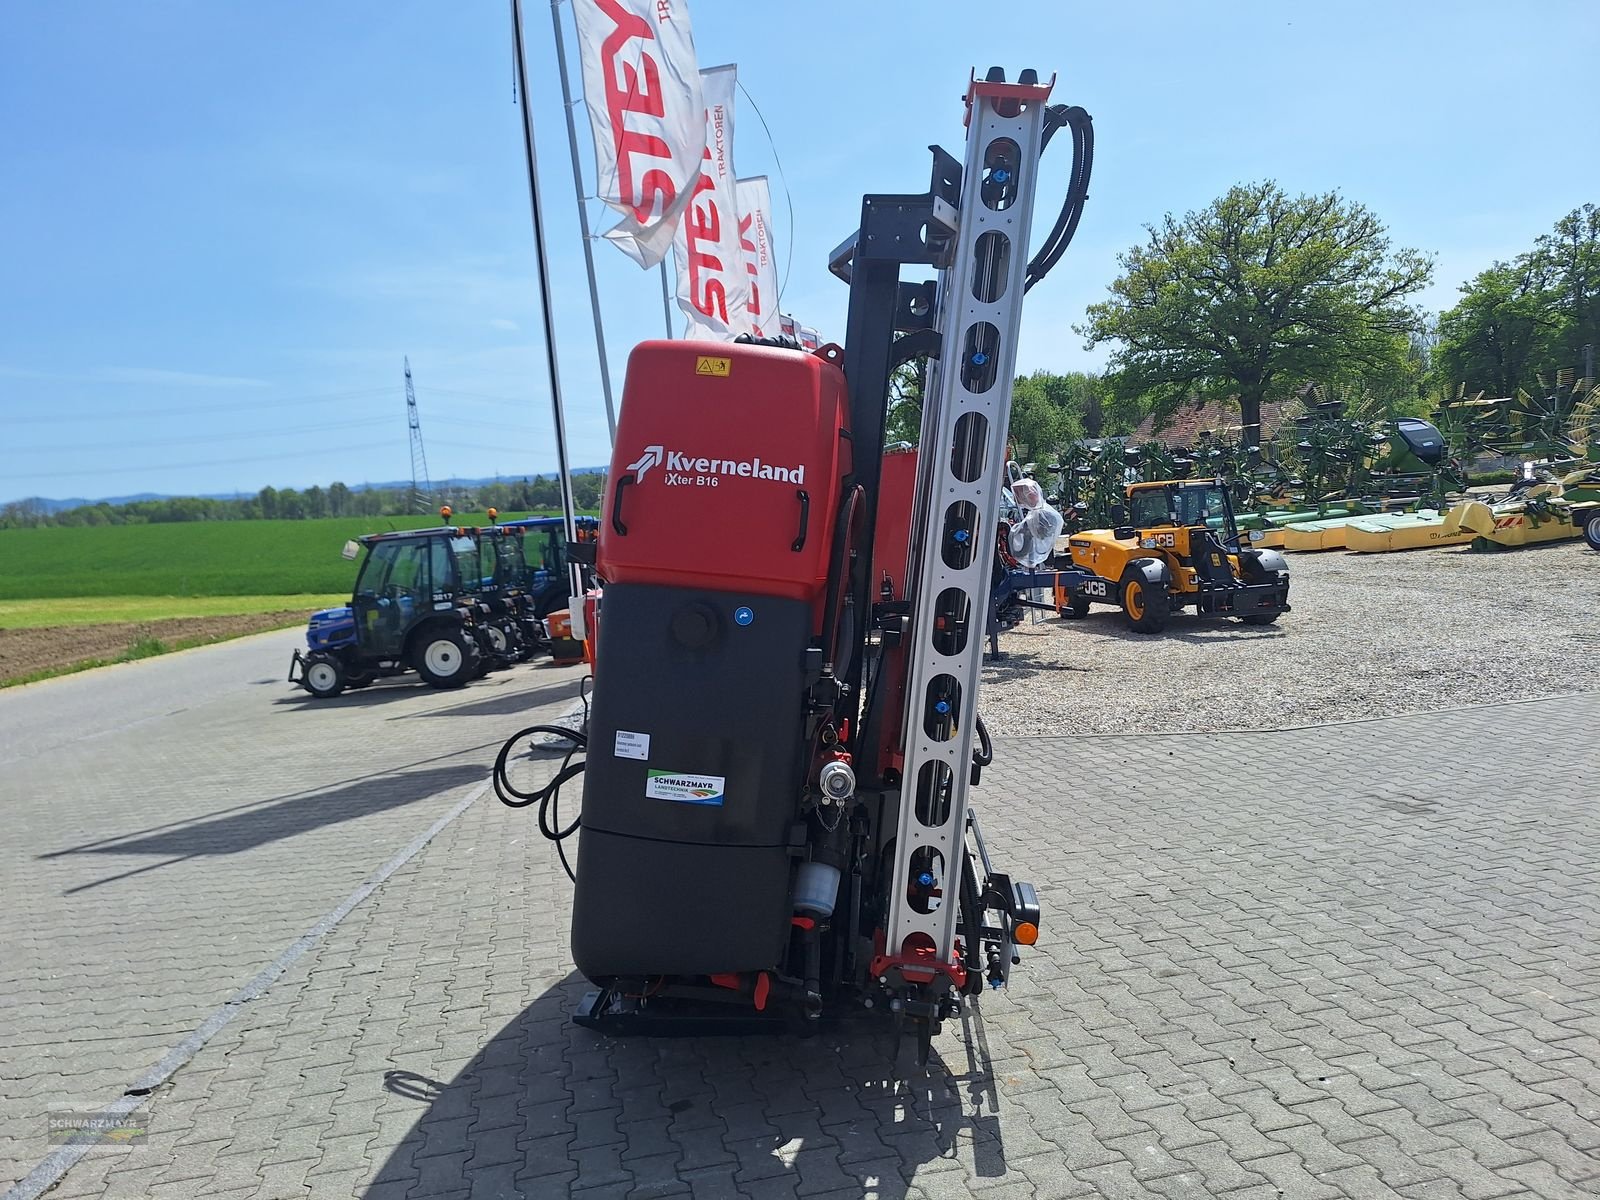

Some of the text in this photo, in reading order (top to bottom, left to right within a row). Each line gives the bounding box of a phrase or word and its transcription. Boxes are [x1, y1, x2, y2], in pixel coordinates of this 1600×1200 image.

[714, 105, 726, 179] TRAKTOREN
[666, 451, 805, 485] Kverneland
[665, 473, 719, 487] iXter B16
[1084, 580, 1107, 597] JCB
[432, 592, 453, 601] 3217
[654, 776, 713, 789] SCHWARZMAYR
